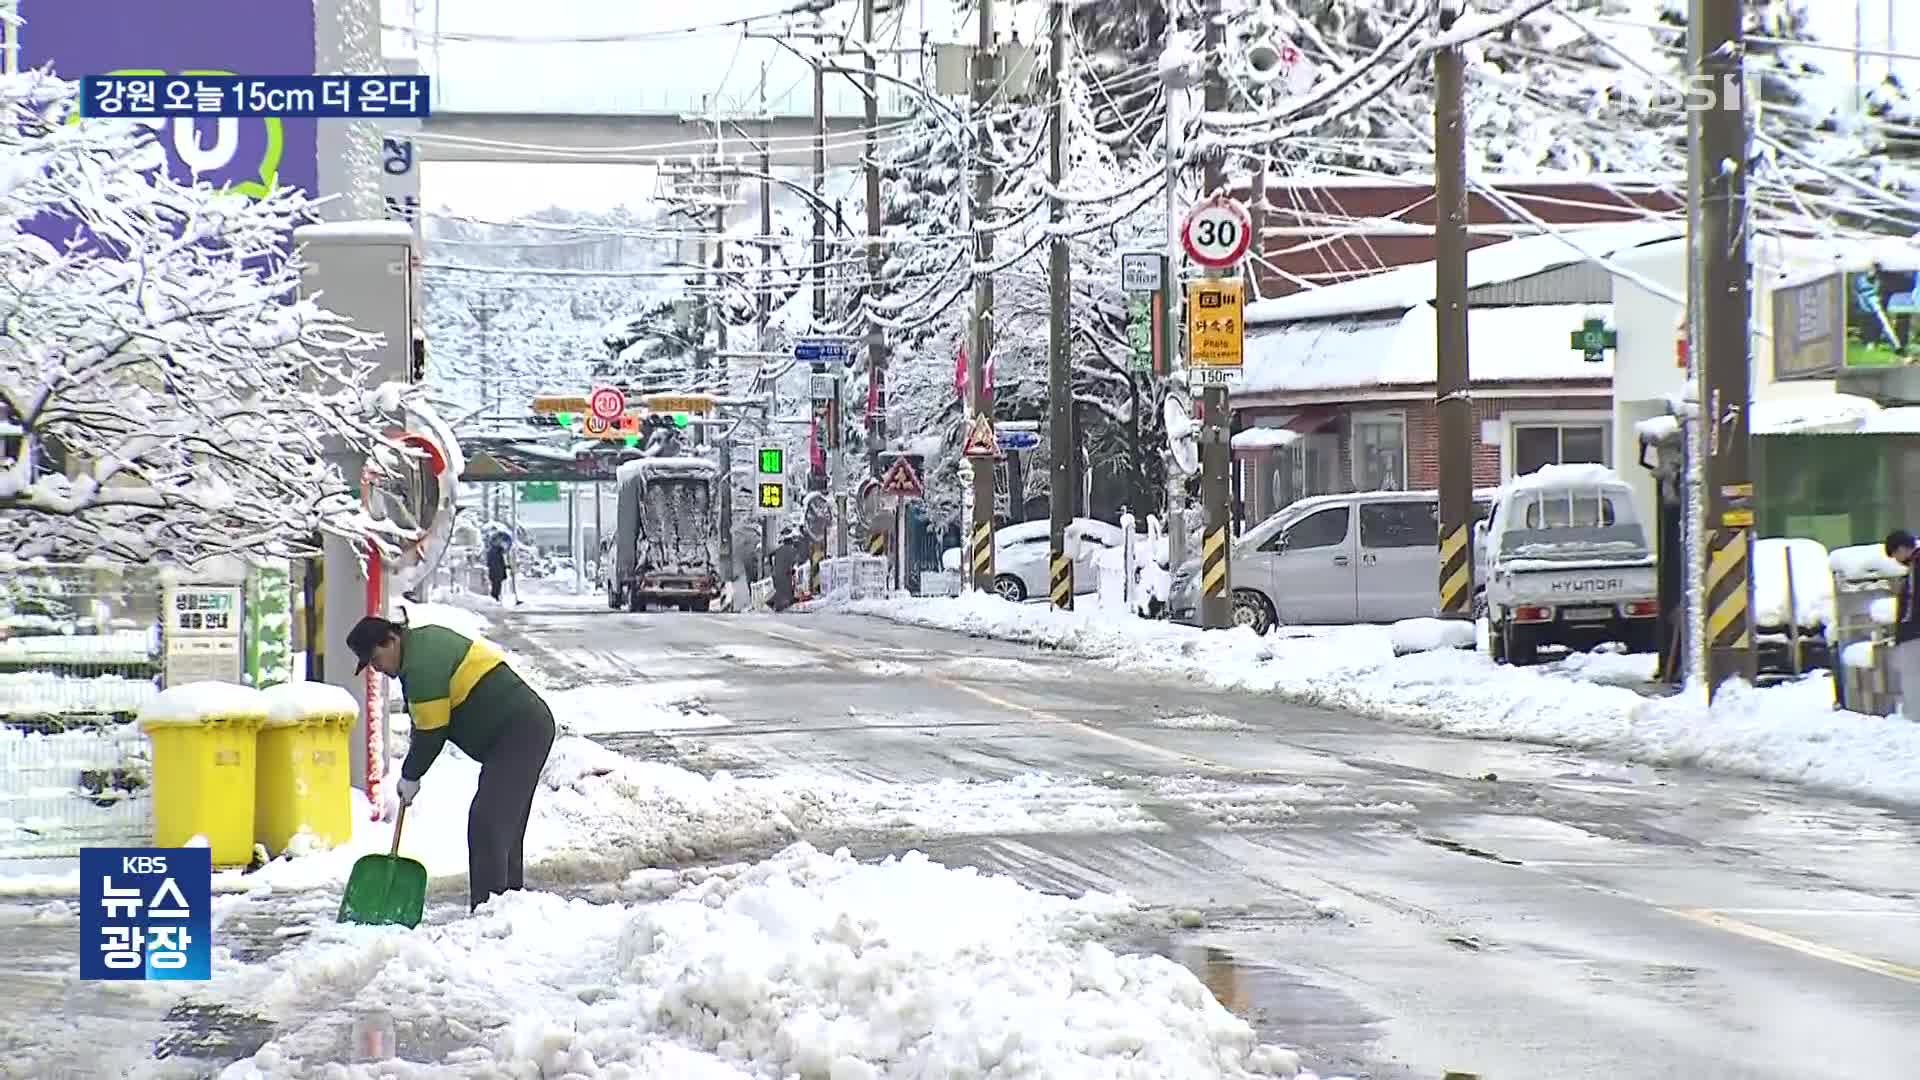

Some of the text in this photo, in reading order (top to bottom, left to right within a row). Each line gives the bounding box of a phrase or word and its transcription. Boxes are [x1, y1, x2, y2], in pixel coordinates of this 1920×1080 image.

[1197, 219, 1236, 247] 30
[1201, 369, 1234, 382] 150m
[1551, 578, 1624, 592] HYUNDAI
[205, 612, 229, 630] 안내
